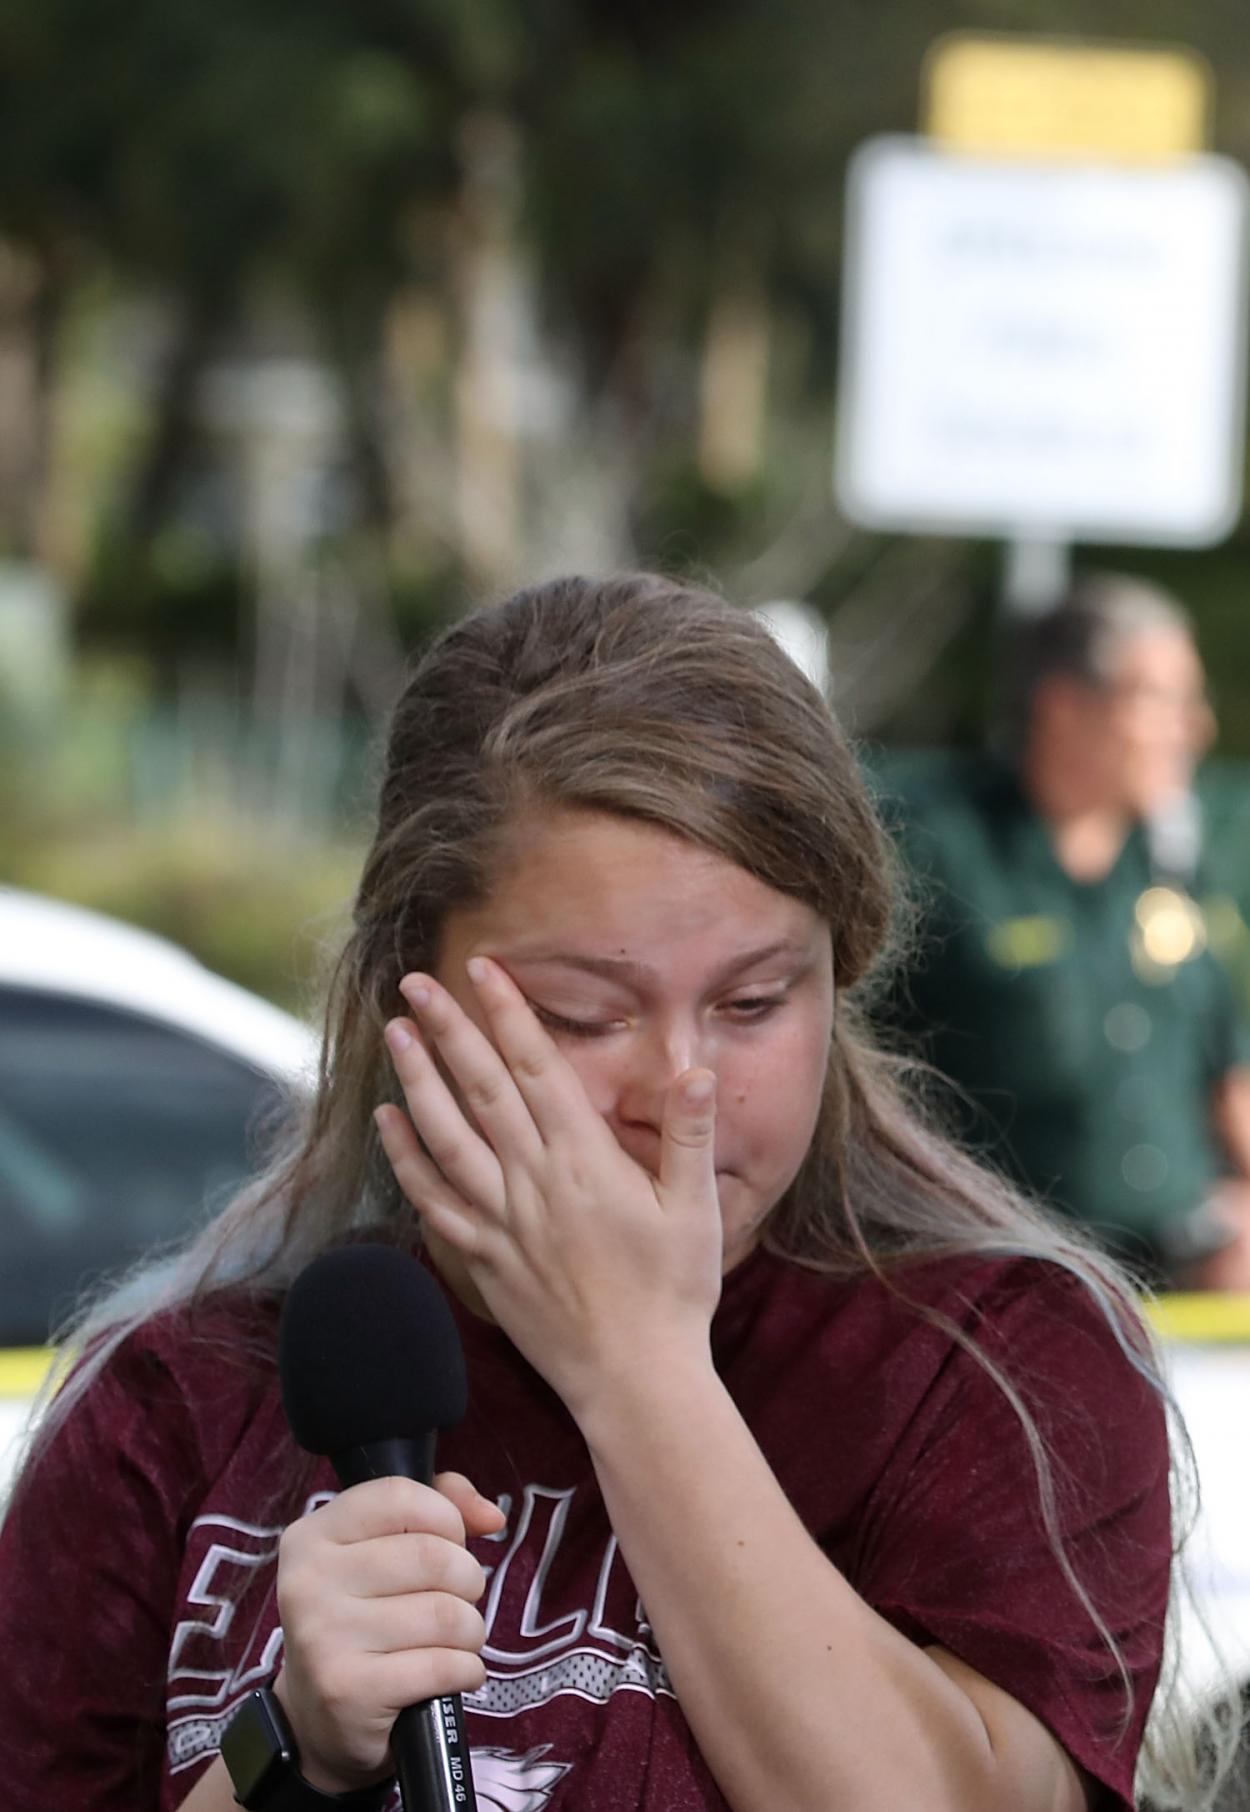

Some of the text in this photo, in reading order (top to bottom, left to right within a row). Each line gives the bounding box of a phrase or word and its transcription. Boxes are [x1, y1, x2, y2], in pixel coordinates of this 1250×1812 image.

[442, 1697, 467, 1802] ISER MD 46
